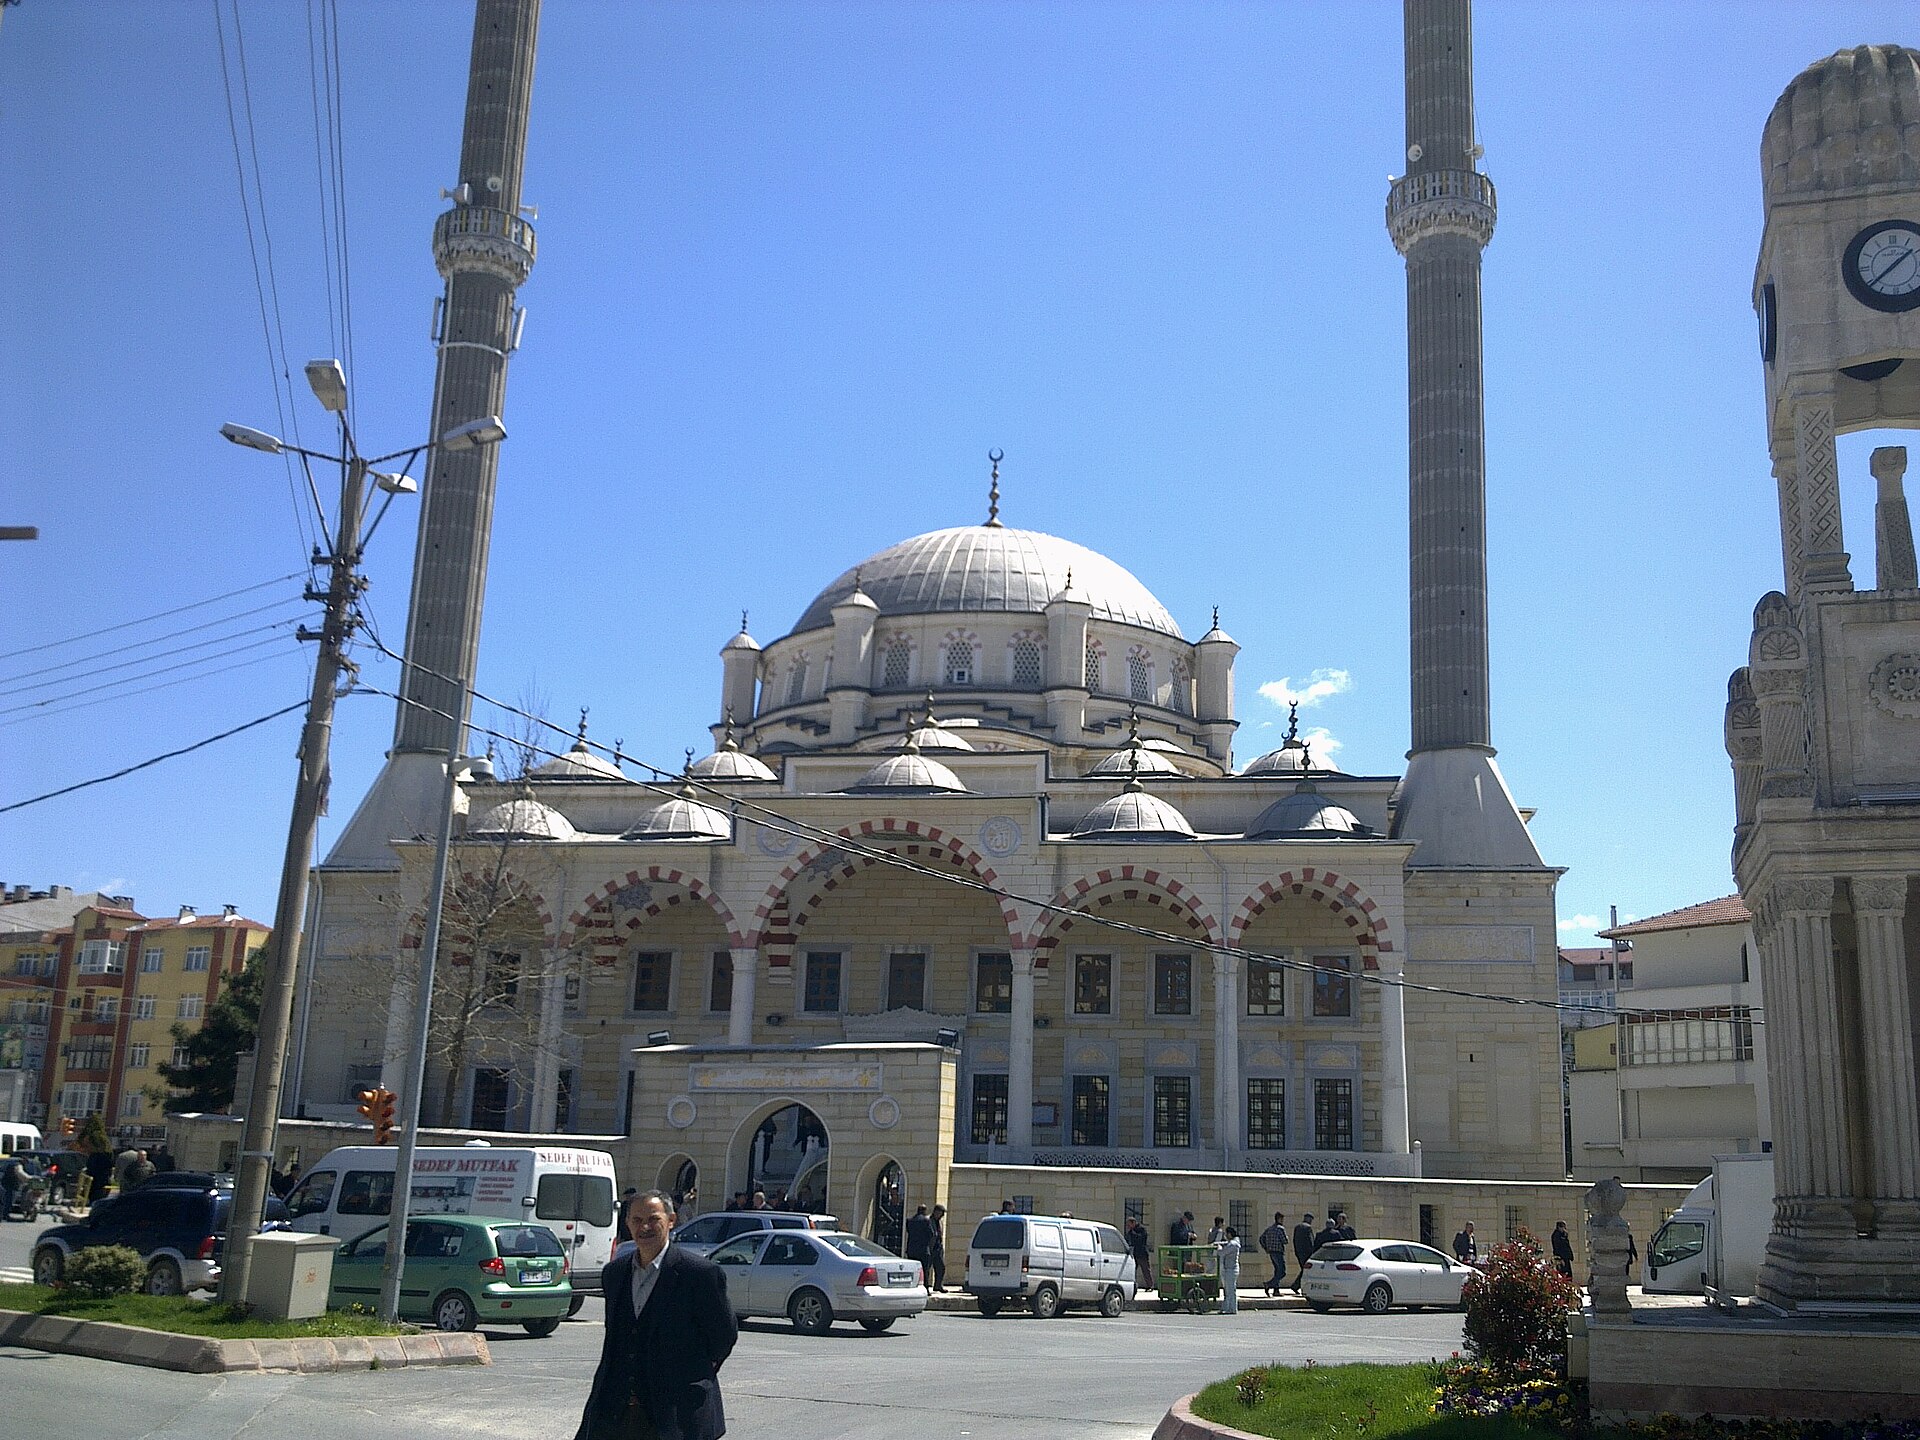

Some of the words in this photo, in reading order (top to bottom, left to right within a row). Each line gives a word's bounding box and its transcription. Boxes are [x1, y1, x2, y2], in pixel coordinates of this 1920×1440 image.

[456, 1159, 520, 1172] MUTFAK
[539, 1153, 572, 1163] SEDEF
[577, 1154, 611, 1167] MUTFAK
